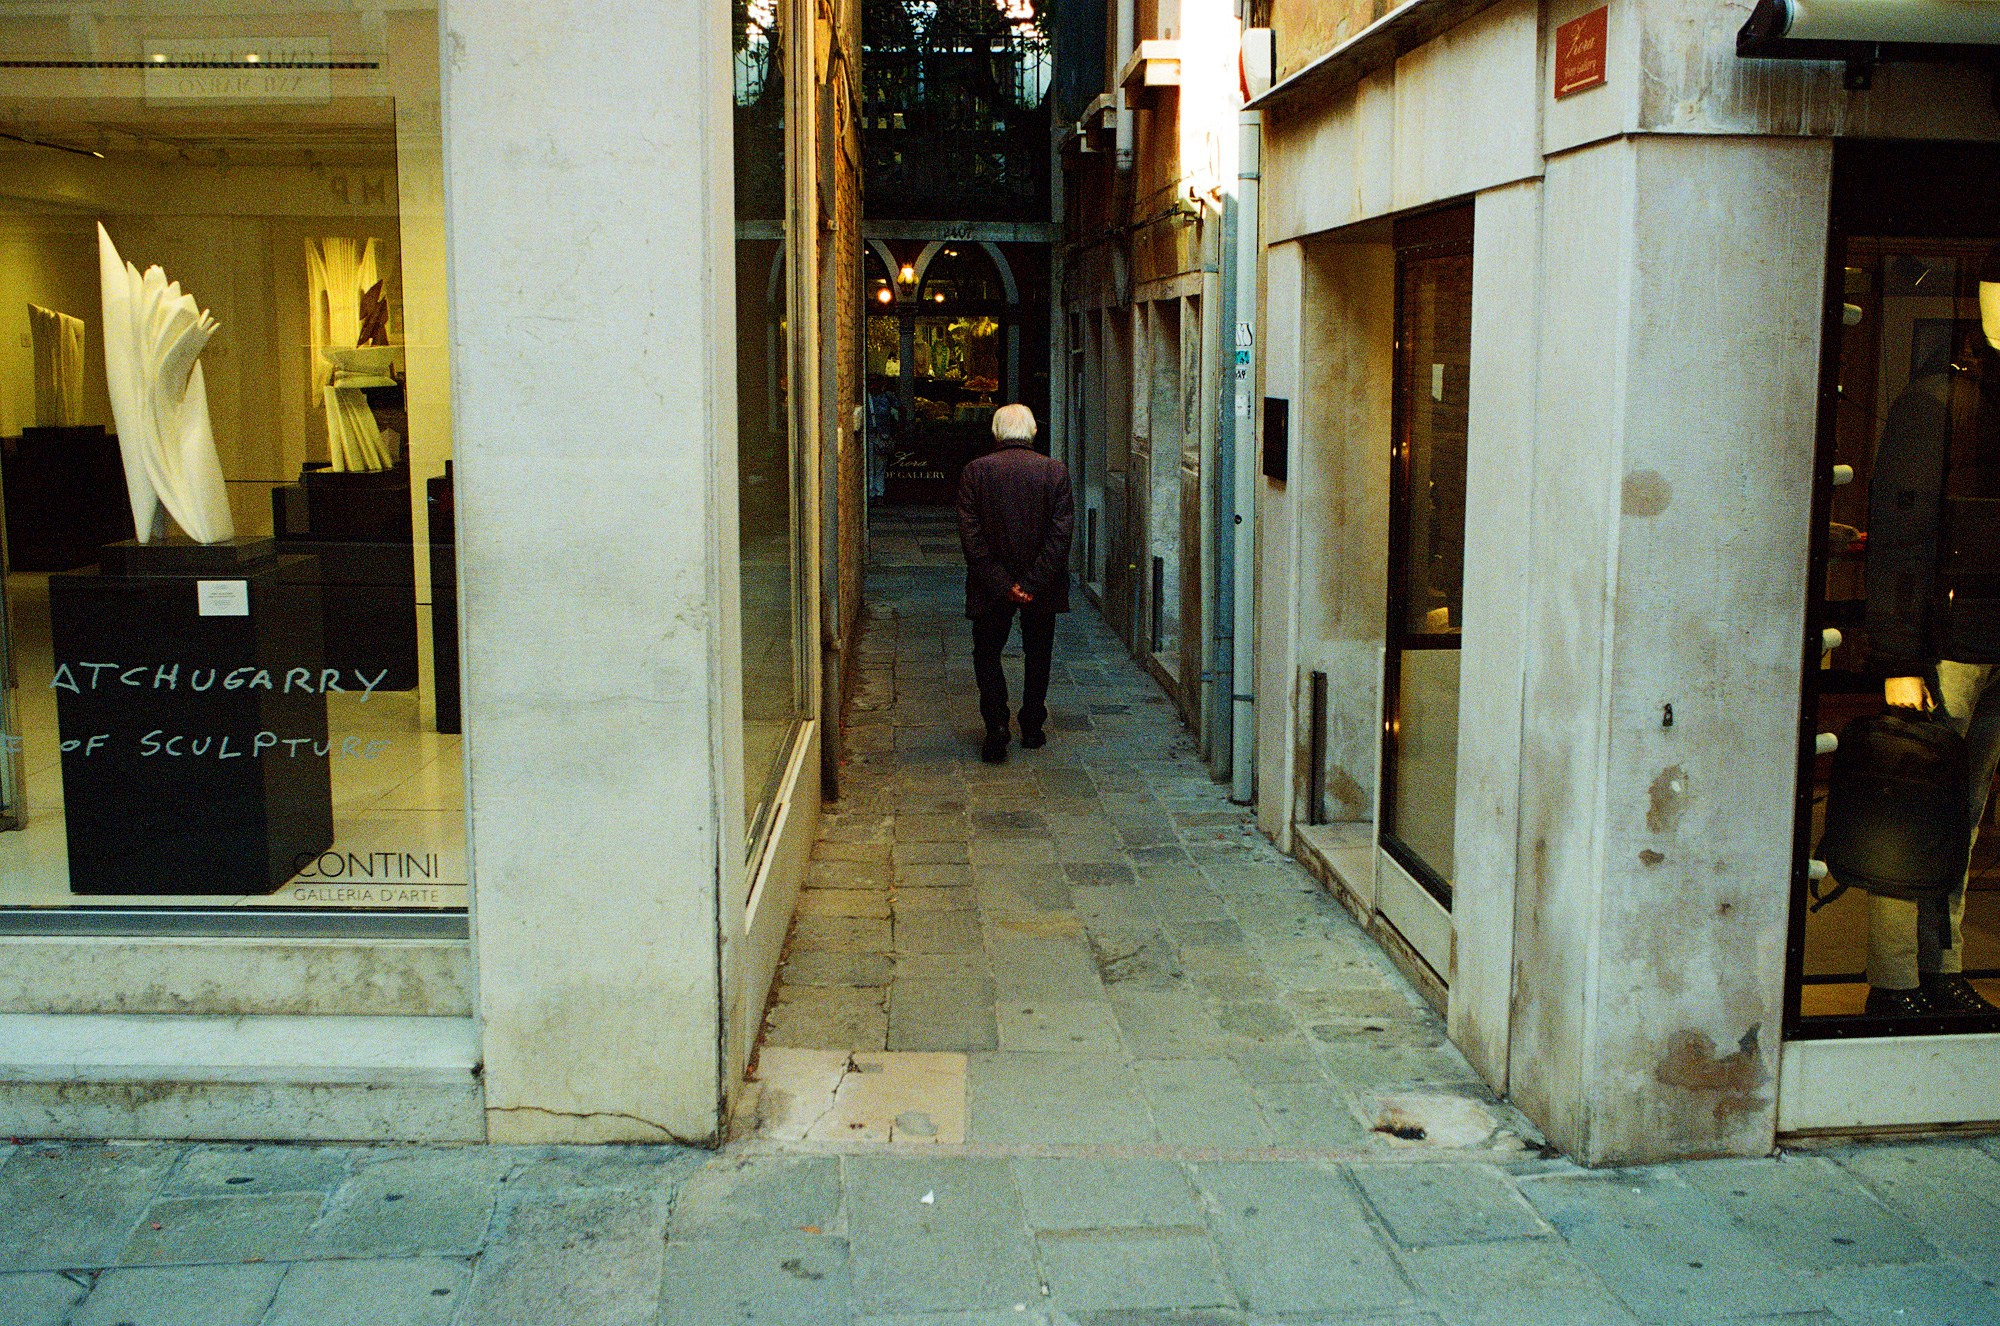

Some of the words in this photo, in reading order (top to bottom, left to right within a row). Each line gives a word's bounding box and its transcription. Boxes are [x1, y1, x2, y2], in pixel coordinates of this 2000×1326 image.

[897, 471, 945, 479] GALLERY
[48, 661, 388, 703] ATCHUGARRY
[59, 733, 110, 757] OF
[139, 729, 392, 761] SCULPTURE
[293, 851, 439, 879] CONTINI
[293, 888, 374, 902] GALLERIA
[380, 888, 440, 903] D'ARTE
